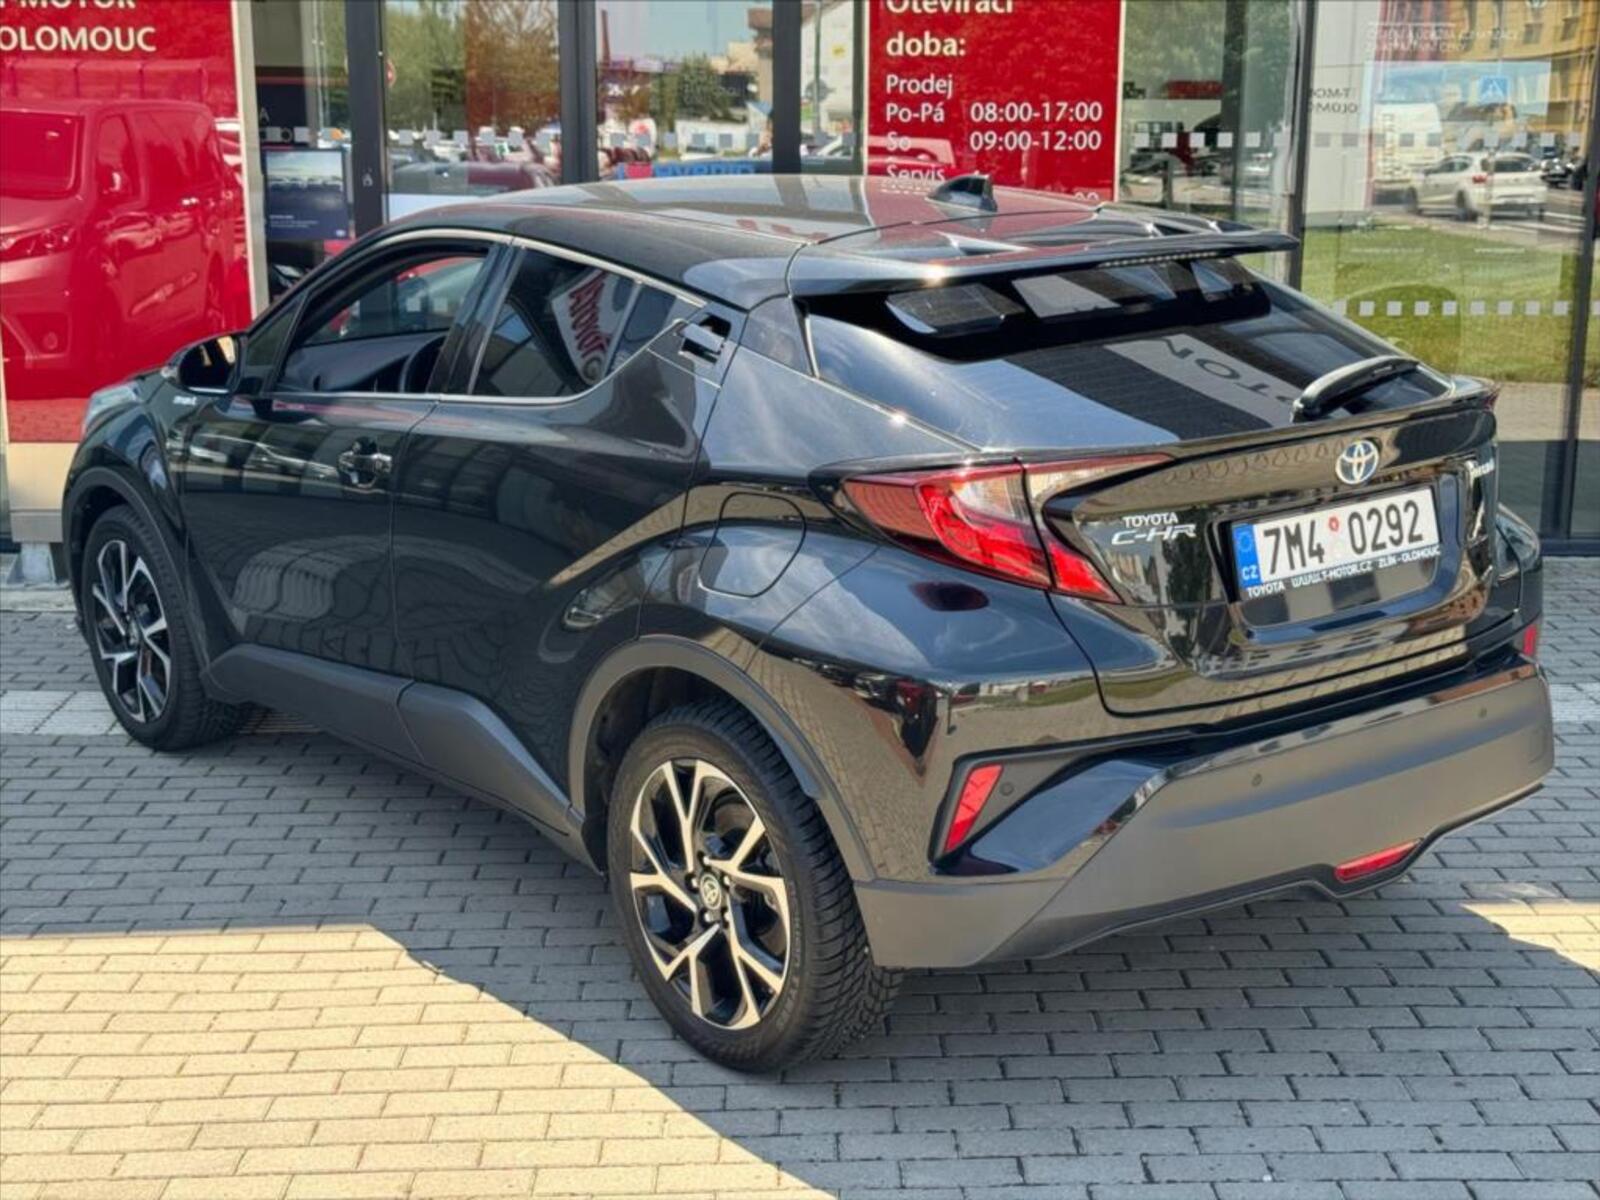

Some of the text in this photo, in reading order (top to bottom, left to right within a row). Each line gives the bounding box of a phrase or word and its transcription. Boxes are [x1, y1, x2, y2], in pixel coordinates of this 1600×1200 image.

[0, 26, 157, 51] OLOMOUC
[886, 30, 966, 56] doba:
[886, 73, 953, 100] Prodej
[886, 102, 1103, 122] Po-Pá 08:00-17:00
[886, 130, 1102, 151] So 09:00-12:00
[1122, 511, 1179, 528] TOYOTA
[1111, 523, 1197, 545] C-HR
[1263, 499, 1424, 575] 7M4 0292
[1242, 564, 1259, 581] CZ
[1247, 580, 1286, 599] TOYOTA
